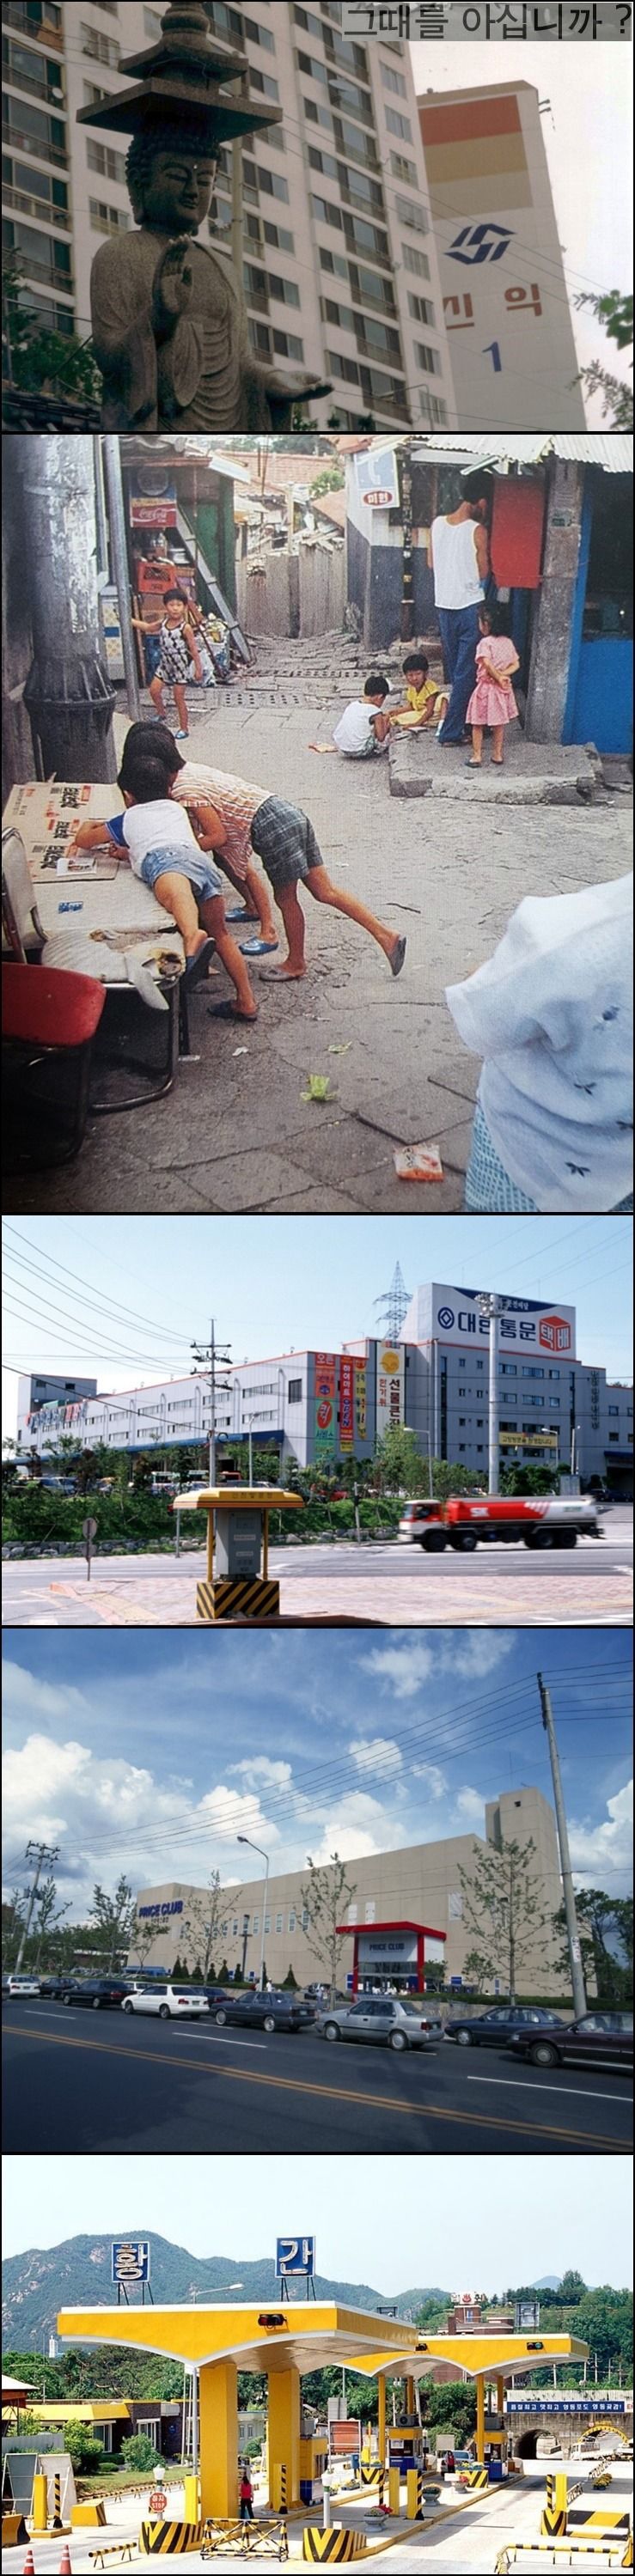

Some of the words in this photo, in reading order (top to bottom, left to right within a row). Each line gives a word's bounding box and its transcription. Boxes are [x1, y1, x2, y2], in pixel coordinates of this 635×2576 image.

[482, 341, 502, 373] 1
[343, 1364, 351, 1397] 하이마트
[343, 1398, 351, 1428] OPEN
[470, 1507, 490, 1518] SK
[138, 1903, 161, 1918] PRICE
[162, 1900, 183, 1916] CLUB
[388, 1942, 405, 1951] CLUB
[114, 2244, 148, 2281] 황
[278, 2238, 313, 2275] 간
